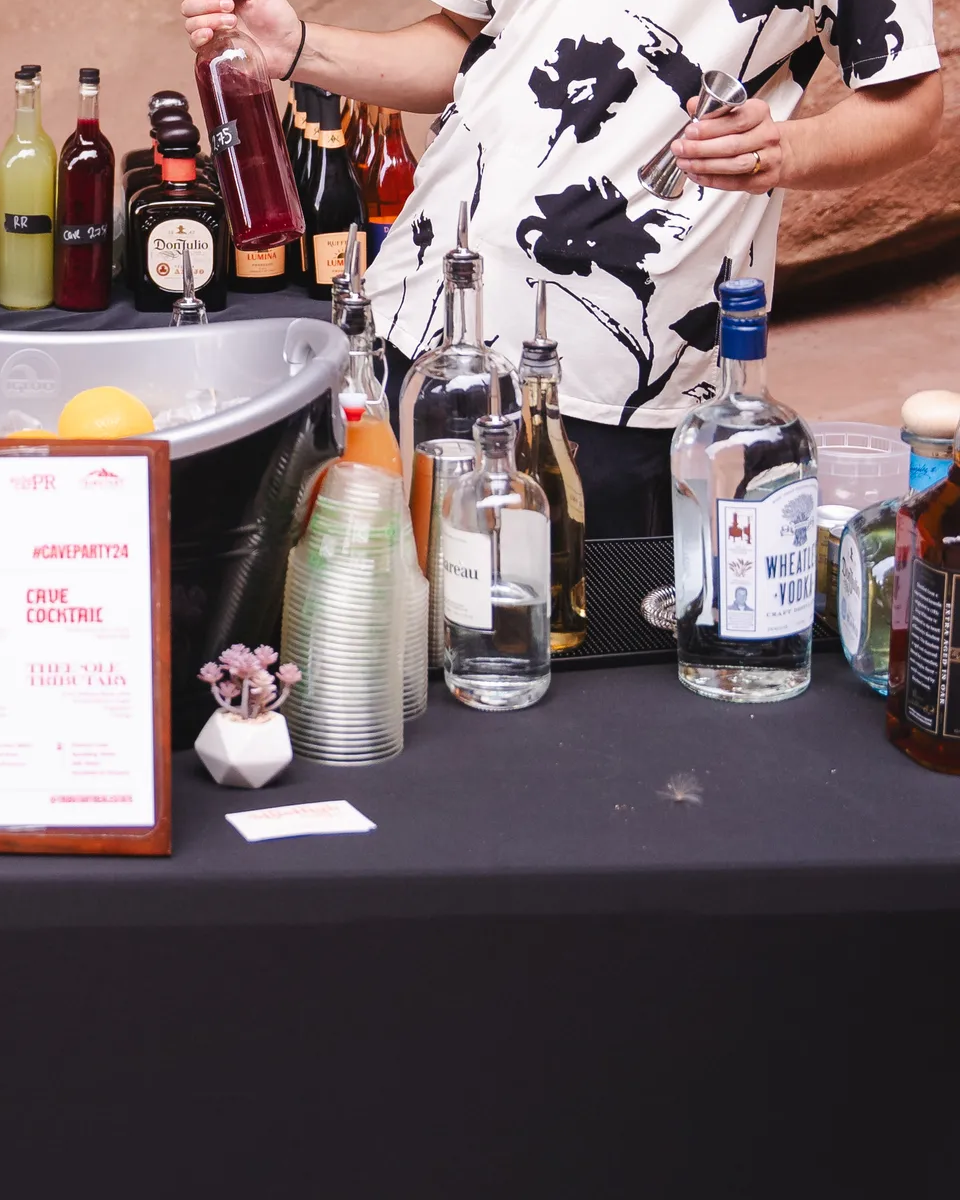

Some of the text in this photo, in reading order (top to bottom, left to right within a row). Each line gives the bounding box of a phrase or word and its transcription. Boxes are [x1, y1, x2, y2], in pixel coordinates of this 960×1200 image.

[13, 215, 28, 229] RR
[247, 252, 277, 261] LUMINA
[32, 544, 129, 559] #CAVEPARTY24
[443, 559, 479, 580] areau
[26, 588, 69, 604] CAVE
[26, 607, 104, 623] COCKTAIL
